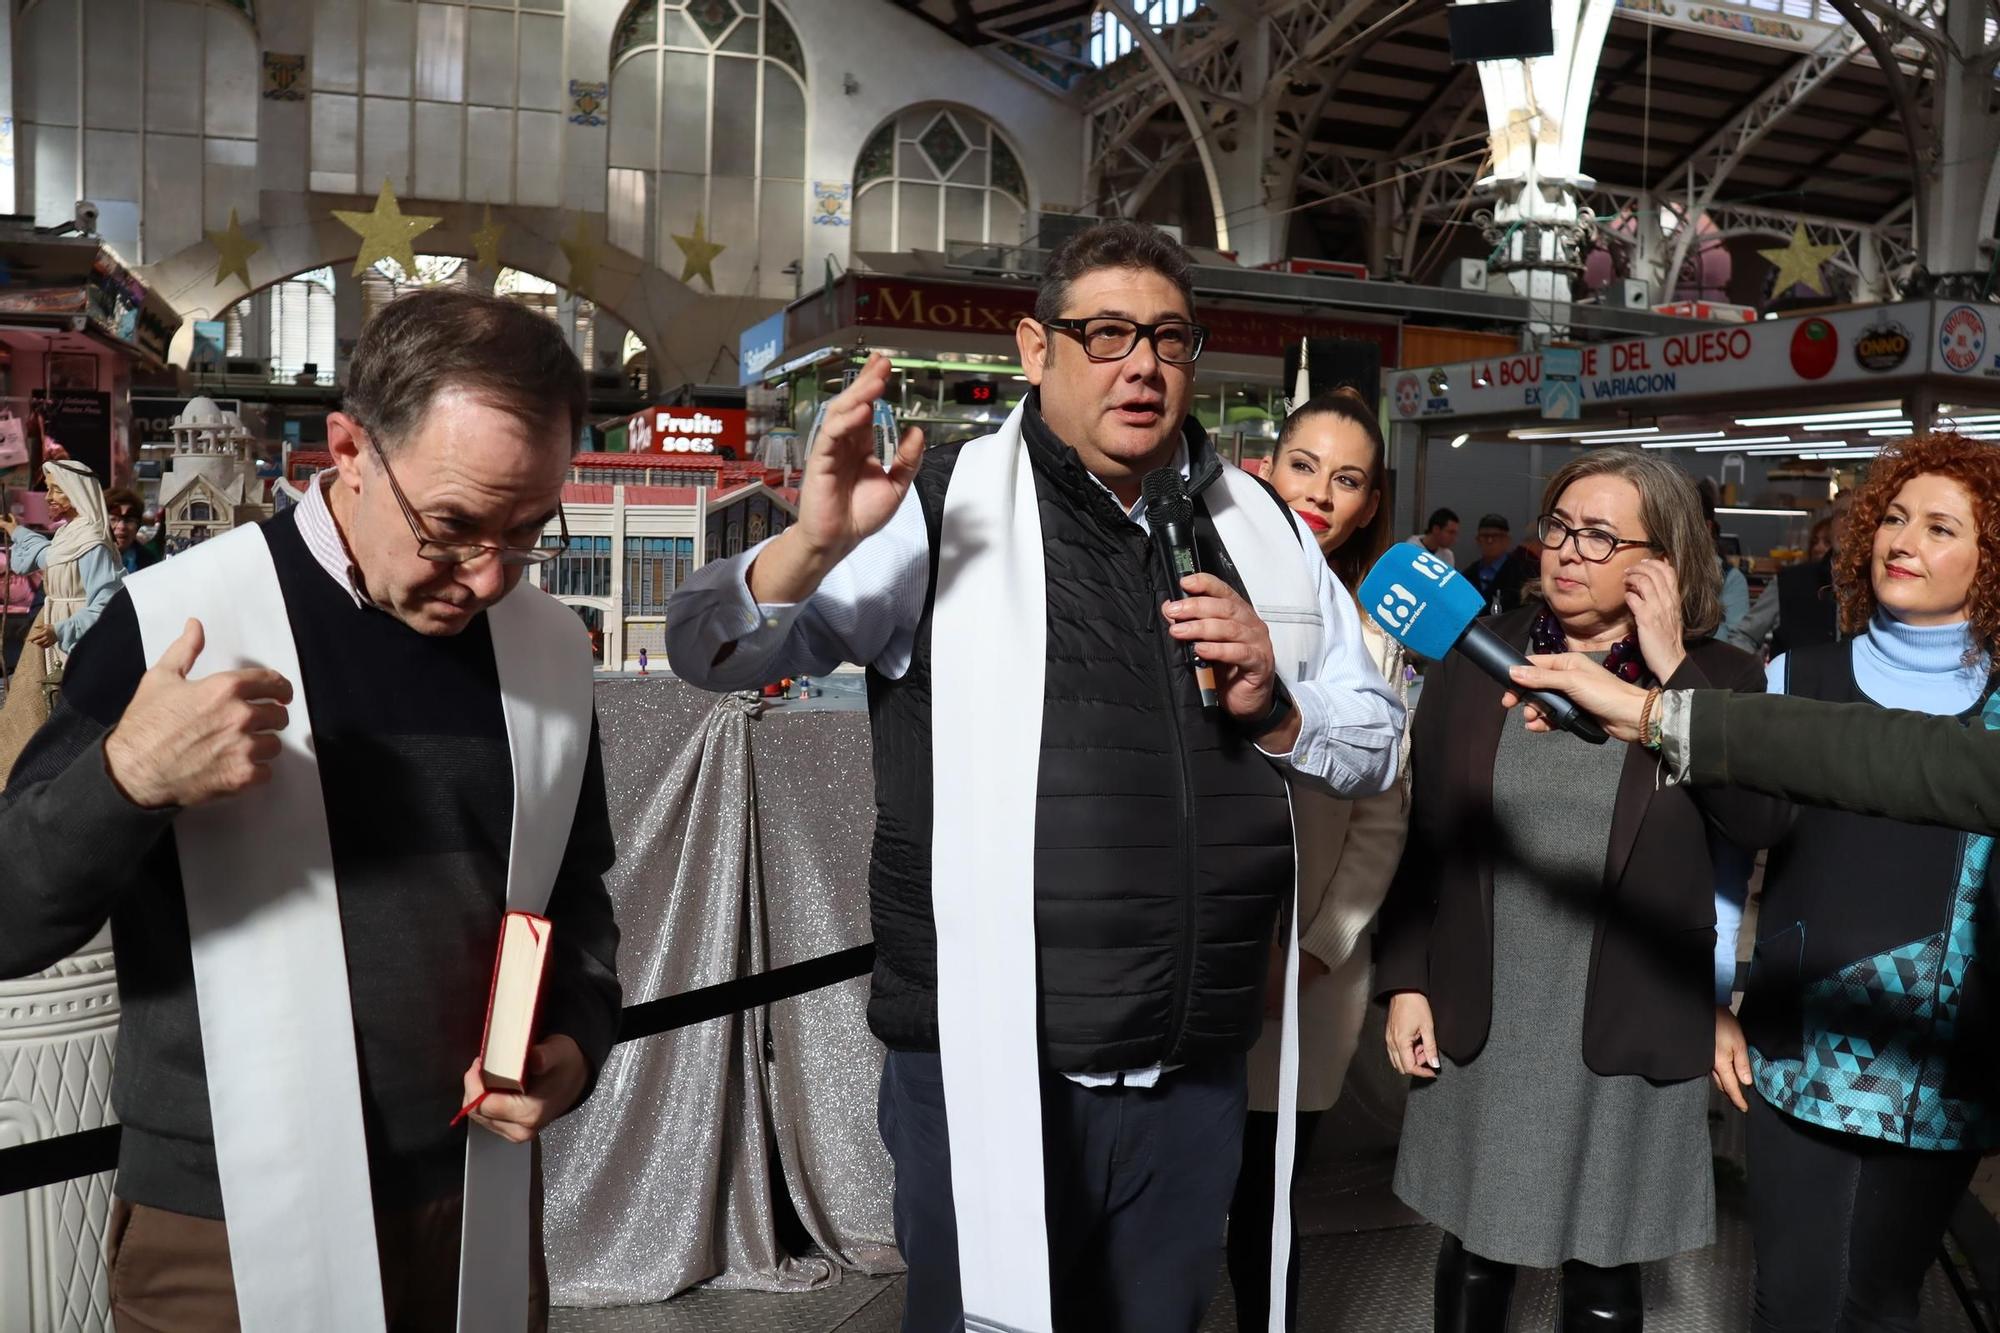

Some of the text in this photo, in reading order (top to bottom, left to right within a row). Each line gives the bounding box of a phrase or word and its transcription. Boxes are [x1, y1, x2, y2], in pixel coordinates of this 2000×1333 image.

[1471, 363, 1495, 390] LA
[1612, 341, 1652, 373] DEL
[1663, 328, 1751, 367] QUESO
[1593, 373, 1676, 399] VARIACION
[656, 412, 723, 435] Fruits
